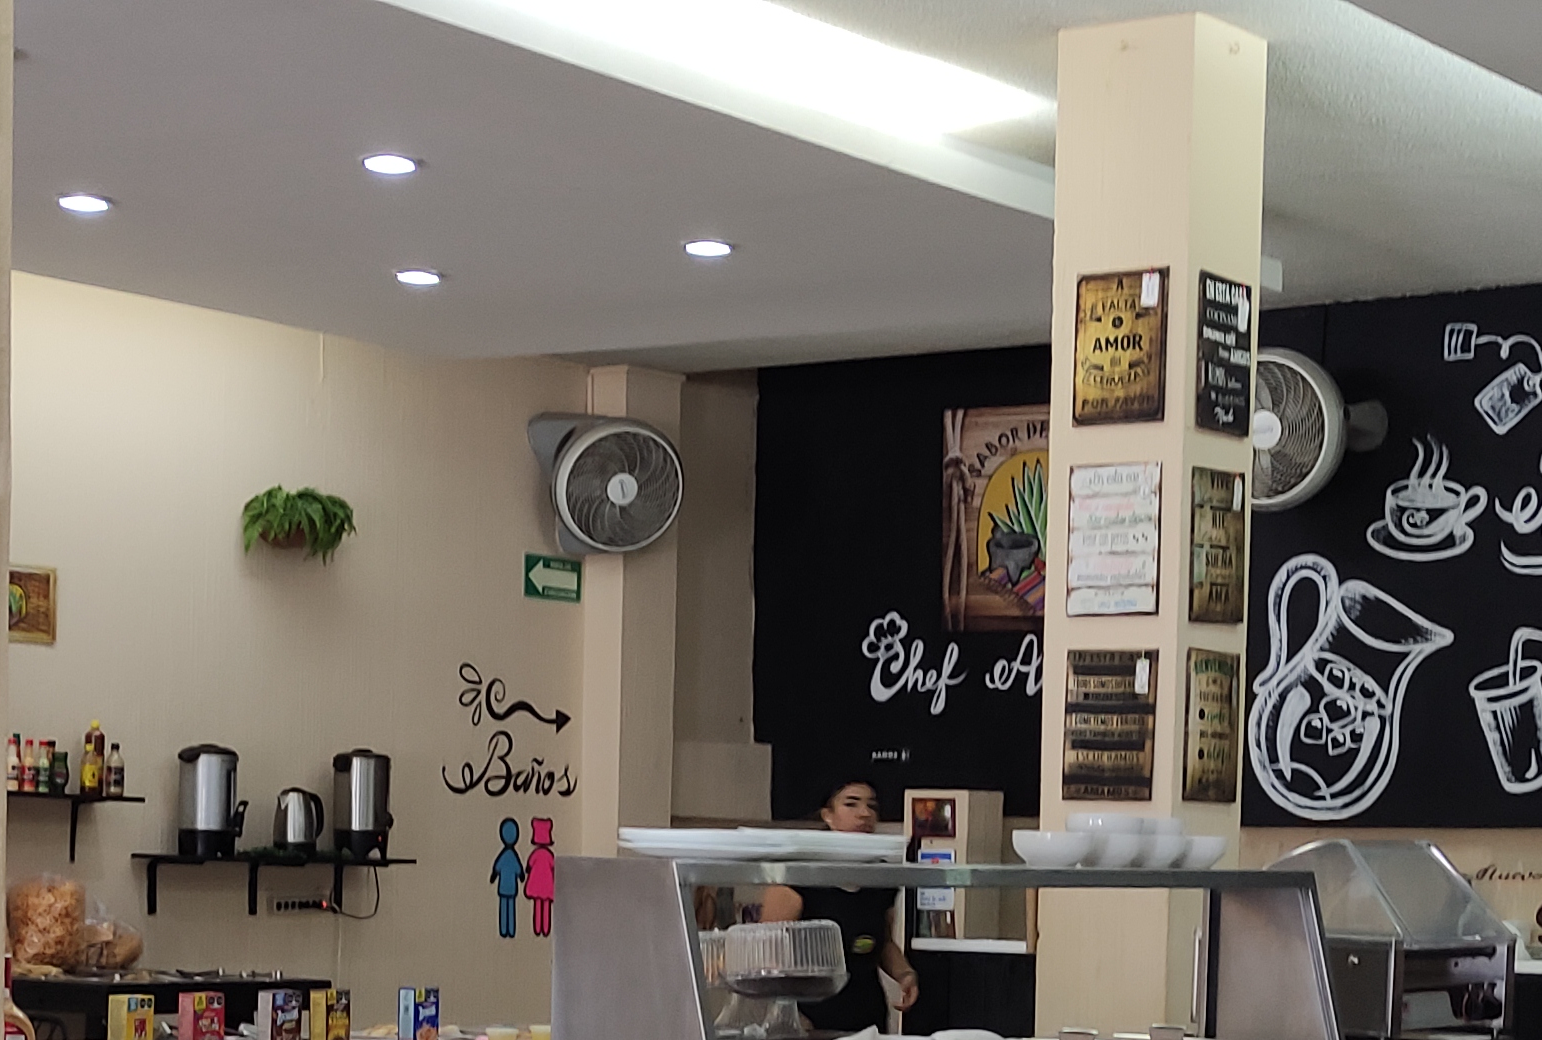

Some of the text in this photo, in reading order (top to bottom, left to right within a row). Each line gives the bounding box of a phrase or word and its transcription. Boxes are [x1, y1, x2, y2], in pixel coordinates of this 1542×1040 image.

[1116, 275, 1124, 291] A
[1101, 298, 1138, 314] FALTA
[1092, 333, 1144, 354] AMOR
[1093, 370, 1143, 389] CERVEZA
[1081, 397, 1109, 411] POR
[967, 426, 1022, 479] SABOR
[865, 622, 1045, 716] Chef A
[442, 730, 578, 797] Baños
[1082, 785, 1130, 797] AMAMOS
